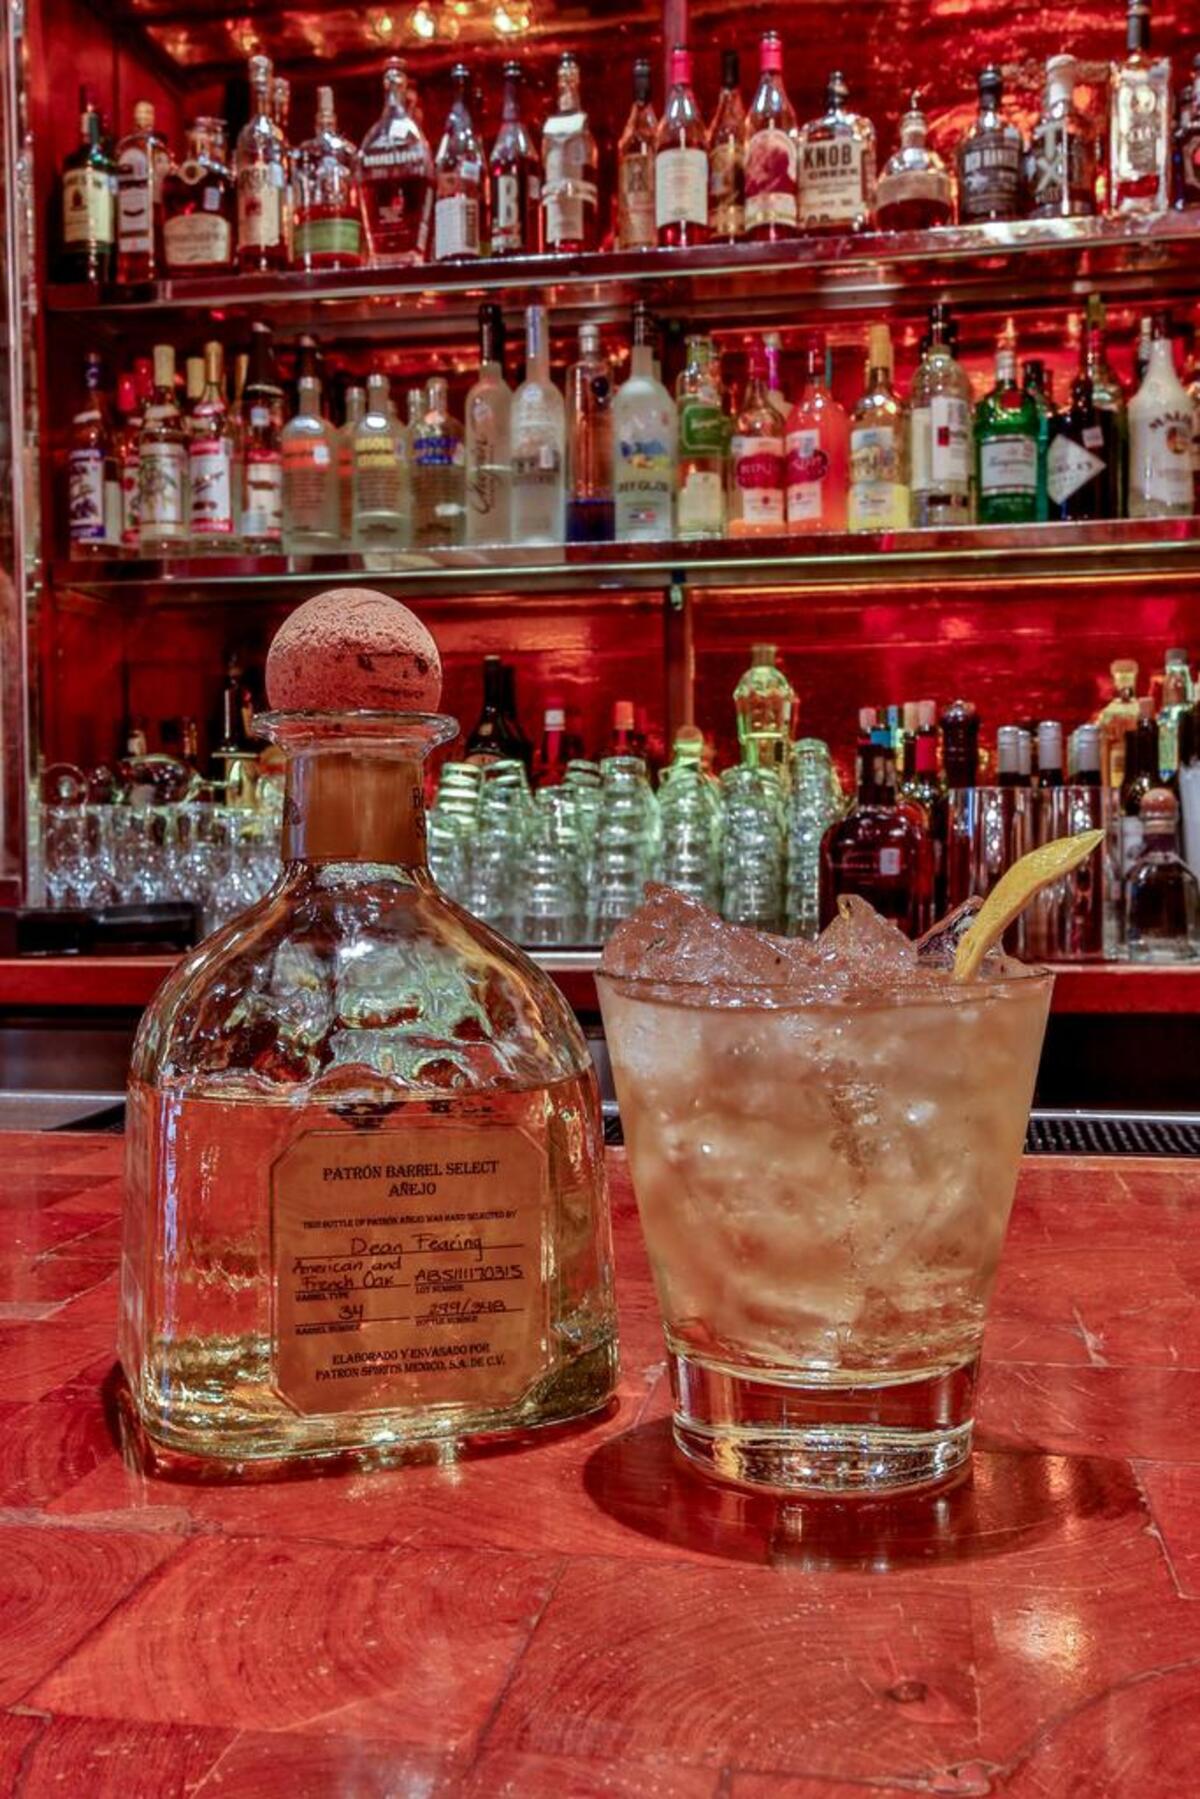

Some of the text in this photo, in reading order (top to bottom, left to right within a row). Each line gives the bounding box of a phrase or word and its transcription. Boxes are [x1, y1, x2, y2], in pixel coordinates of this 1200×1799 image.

[803, 143, 852, 170] KNOB
[323, 1160, 500, 1181] PATRÓN BARREL SELECT
[388, 1182, 437, 1197] AÑEJO
[323, 1219, 353, 1228] BOTTLE
[355, 1218, 366, 1227] OF
[426, 1213, 443, 1222] WAS
[506, 1209, 518, 1219] BY
[351, 1237, 403, 1256] Dean
[292, 1255, 402, 1275] American and
[303, 1270, 394, 1291] French Oak
[415, 1285, 430, 1294] LOT
[338, 1303, 364, 1321] 34
[332, 1342, 490, 1366] ELABORADO Y ENVASADO POR
[360, 1364, 402, 1378] SPIRITS
[470, 1357, 485, 1369] DE
